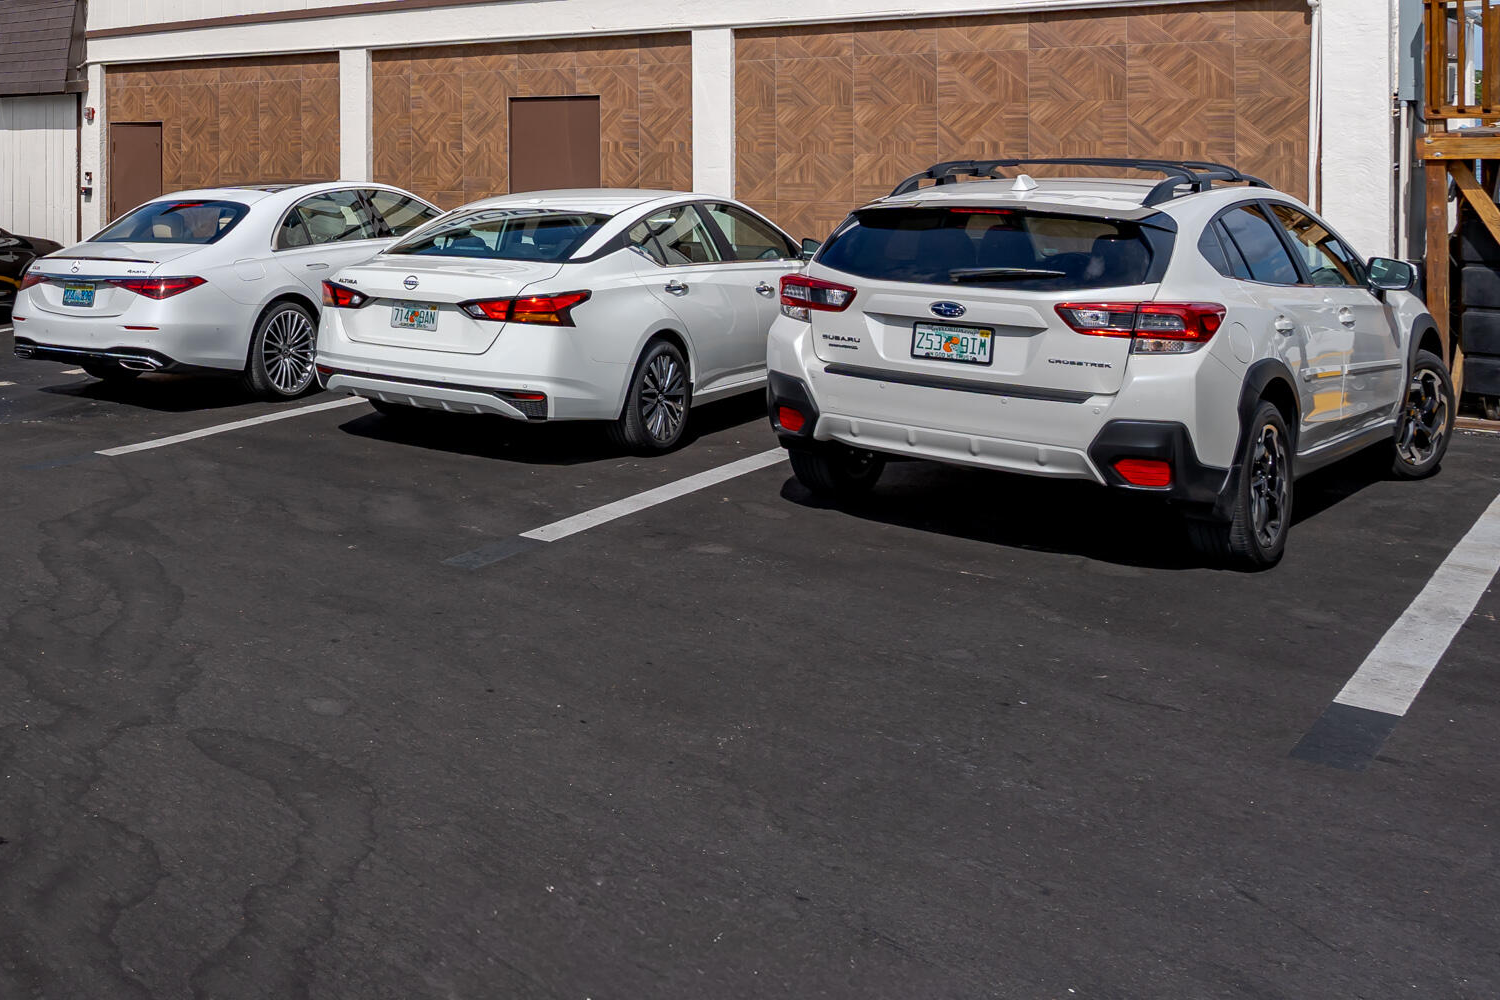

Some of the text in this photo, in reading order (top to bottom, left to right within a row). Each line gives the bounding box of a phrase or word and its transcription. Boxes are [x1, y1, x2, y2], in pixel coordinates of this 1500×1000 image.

[821, 333, 861, 343] SUBARU
[916, 332, 987, 355] Z53 9IM
[1048, 358, 1112, 368] CROSSTREK
